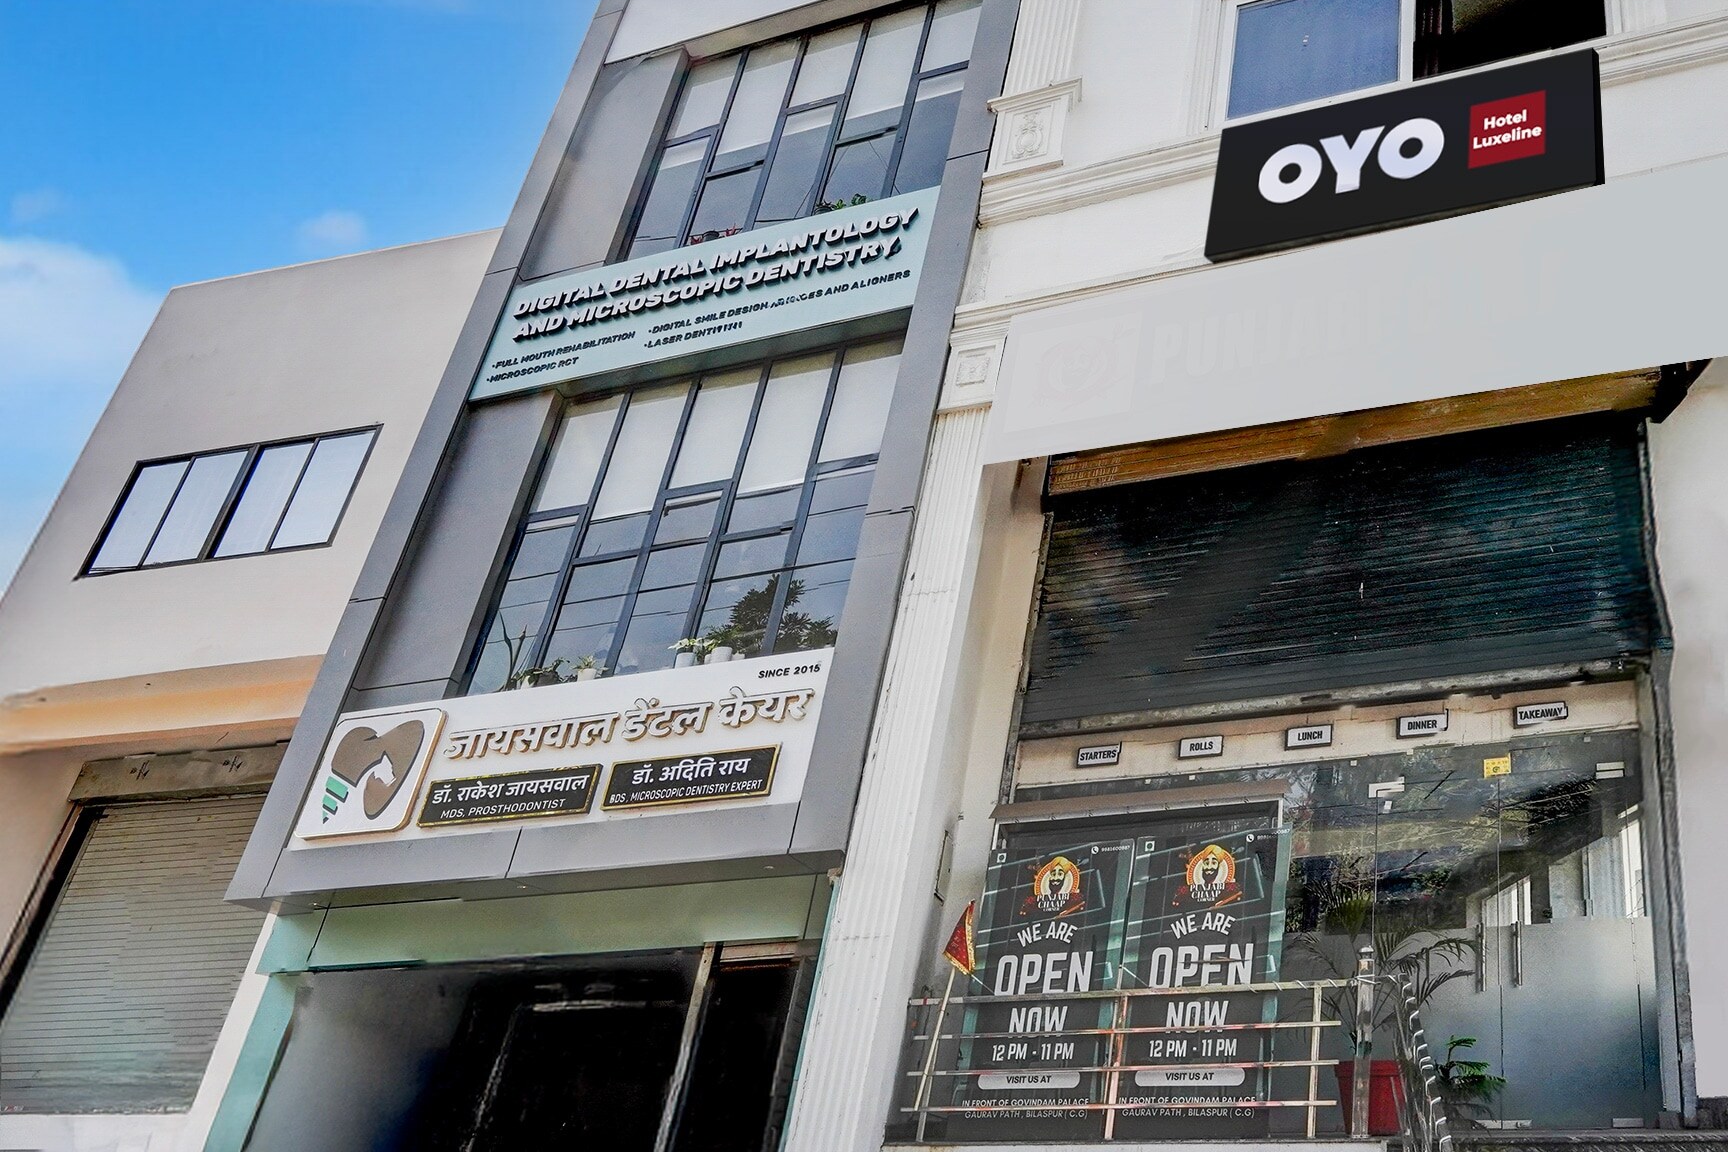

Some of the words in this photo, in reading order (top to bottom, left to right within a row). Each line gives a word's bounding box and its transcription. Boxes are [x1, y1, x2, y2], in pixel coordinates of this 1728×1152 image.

[1483, 109, 1527, 131] Hotel
[1473, 124, 1542, 150] Luxeline
[1258, 117, 1444, 204] OYO
[514, 282, 605, 319] DIGITAL
[609, 260, 706, 295] DENTAL
[711, 208, 918, 272] IMPLANTOLOGY
[513, 314, 567, 343] AND
[567, 273, 743, 330] MICROSCOPIC
[746, 236, 901, 291] DENTISTRY
[651, 319, 692, 334] DIGITAL
[694, 311, 725, 325] SMILE
[727, 300, 768, 318] DESIGN
[824, 284, 850, 296] AND
[850, 269, 911, 290] ALIGNERS
[495, 358, 518, 369] FULL
[521, 349, 556, 364] MOUTH
[556, 331, 636, 356] REHABILITATION
[647, 333, 682, 348] LASER
[489, 362, 556, 383] MICROSCOPIC
[558, 357, 579, 368] RCT
[758, 667, 790, 679] SINCE
[793, 664, 821, 675] 2015
[443, 712, 621, 760] जायसवाल
[621, 697, 714, 742] डेंटल
[718, 686, 815, 728] केयर
[1407, 719, 1437, 730] DINNER
[1518, 707, 1563, 721] TAKEAWAY
[1189, 741, 1213, 752] ROLLS
[1297, 730, 1323, 741] LUNCH
[1080, 749, 1117, 761] STARTERS
[631, 764, 654, 785] डॉ.
[659, 756, 716, 782] अदिति
[718, 757, 751, 776] राय
[432, 784, 452, 804] डॉ.
[457, 780, 503, 802] राकेश
[505, 774, 590, 797] जायसवाल
[630, 787, 685, 802] MICROSCOPIC
[685, 783, 730, 796] DENTISTRY
[730, 779, 763, 792] EXPERT
[468, 799, 566, 816] PROSTHODONTIST
[1017, 923, 1042, 947] WE
[1046, 921, 1078, 943] ARE
[1170, 914, 1197, 939] WE
[1201, 912, 1237, 935] ARE
[994, 951, 1093, 996] OPEN
[1149, 943, 1254, 988] OPEN
[1008, 1006, 1068, 1038] NOW
[1165, 1000, 1229, 1033] NOW
[992, 1044, 1006, 1061] 12
[1007, 1043, 1028, 1060] PM
[1041, 1043, 1051, 1060] 11
[1054, 1042, 1074, 1060] PM
[1149, 1040, 1163, 1057] 12
[1166, 1040, 1187, 1057] PM
[1202, 1039, 1212, 1056] 11
[1216, 1038, 1237, 1056] PM
[1006, 1076, 1027, 1084] VISIT
[971, 1099, 996, 1107] FRONT
[1011, 1098, 1055, 1106] GOVINDAM
[1171, 1096, 1220, 1104] GOVINDAM
[965, 1110, 998, 1119] GAURAV
[1026, 1109, 1063, 1118] BILASPUR
[1122, 1108, 1158, 1117] GAURAV
[1188, 1108, 1228, 1116] BILASPUR
